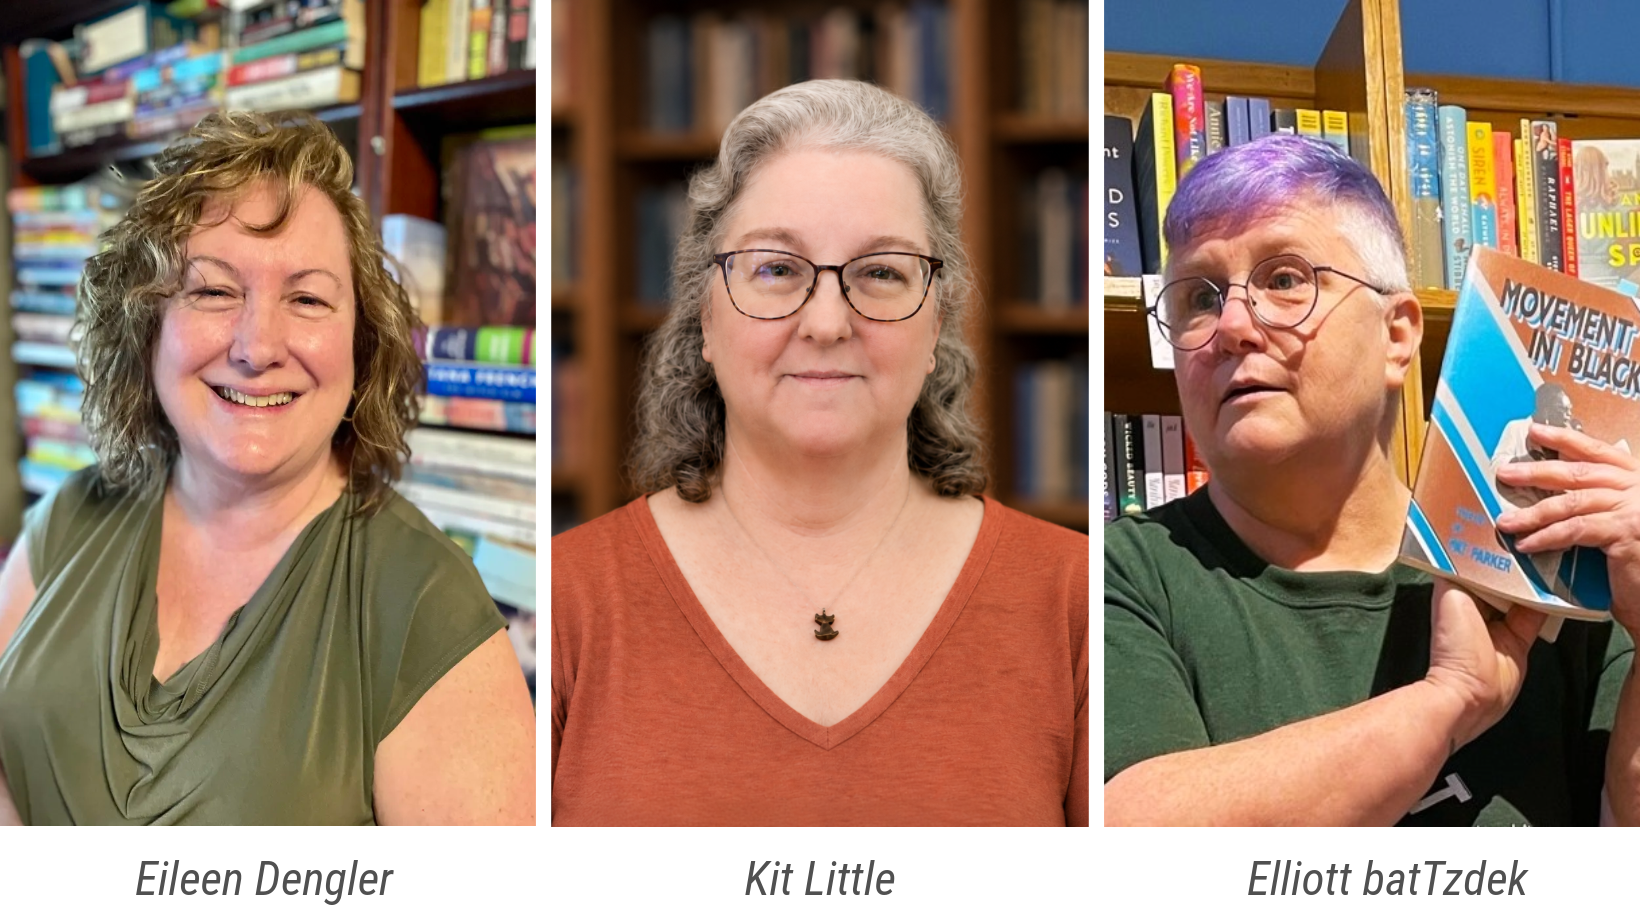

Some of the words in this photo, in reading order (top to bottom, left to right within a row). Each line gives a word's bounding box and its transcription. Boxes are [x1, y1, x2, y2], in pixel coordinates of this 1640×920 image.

[1445, 116, 1457, 170] ASTONISH
[1456, 146, 1466, 170] ONE
[1458, 172, 1467, 193] DAY
[1472, 146, 1486, 186] SIREN
[1449, 172, 1458, 195] THE
[1564, 190, 1572, 206] THE
[1450, 196, 1460, 235] WORLD
[1460, 202, 1470, 235] SHALL
[1547, 176, 1559, 234] RAPHAEL
[1579, 211, 1640, 240] UNLI
[1566, 235, 1575, 263] QUEEN
[1568, 263, 1576, 274] OF
[1500, 278, 1637, 357] MOVEMENT
[1528, 329, 1562, 376] IN
[1568, 342, 1640, 402] BLACK
[1124, 421, 1134, 460] WICKED
[1126, 462, 1136, 500] BEAUTY
[1470, 546, 1513, 574] PARKER
